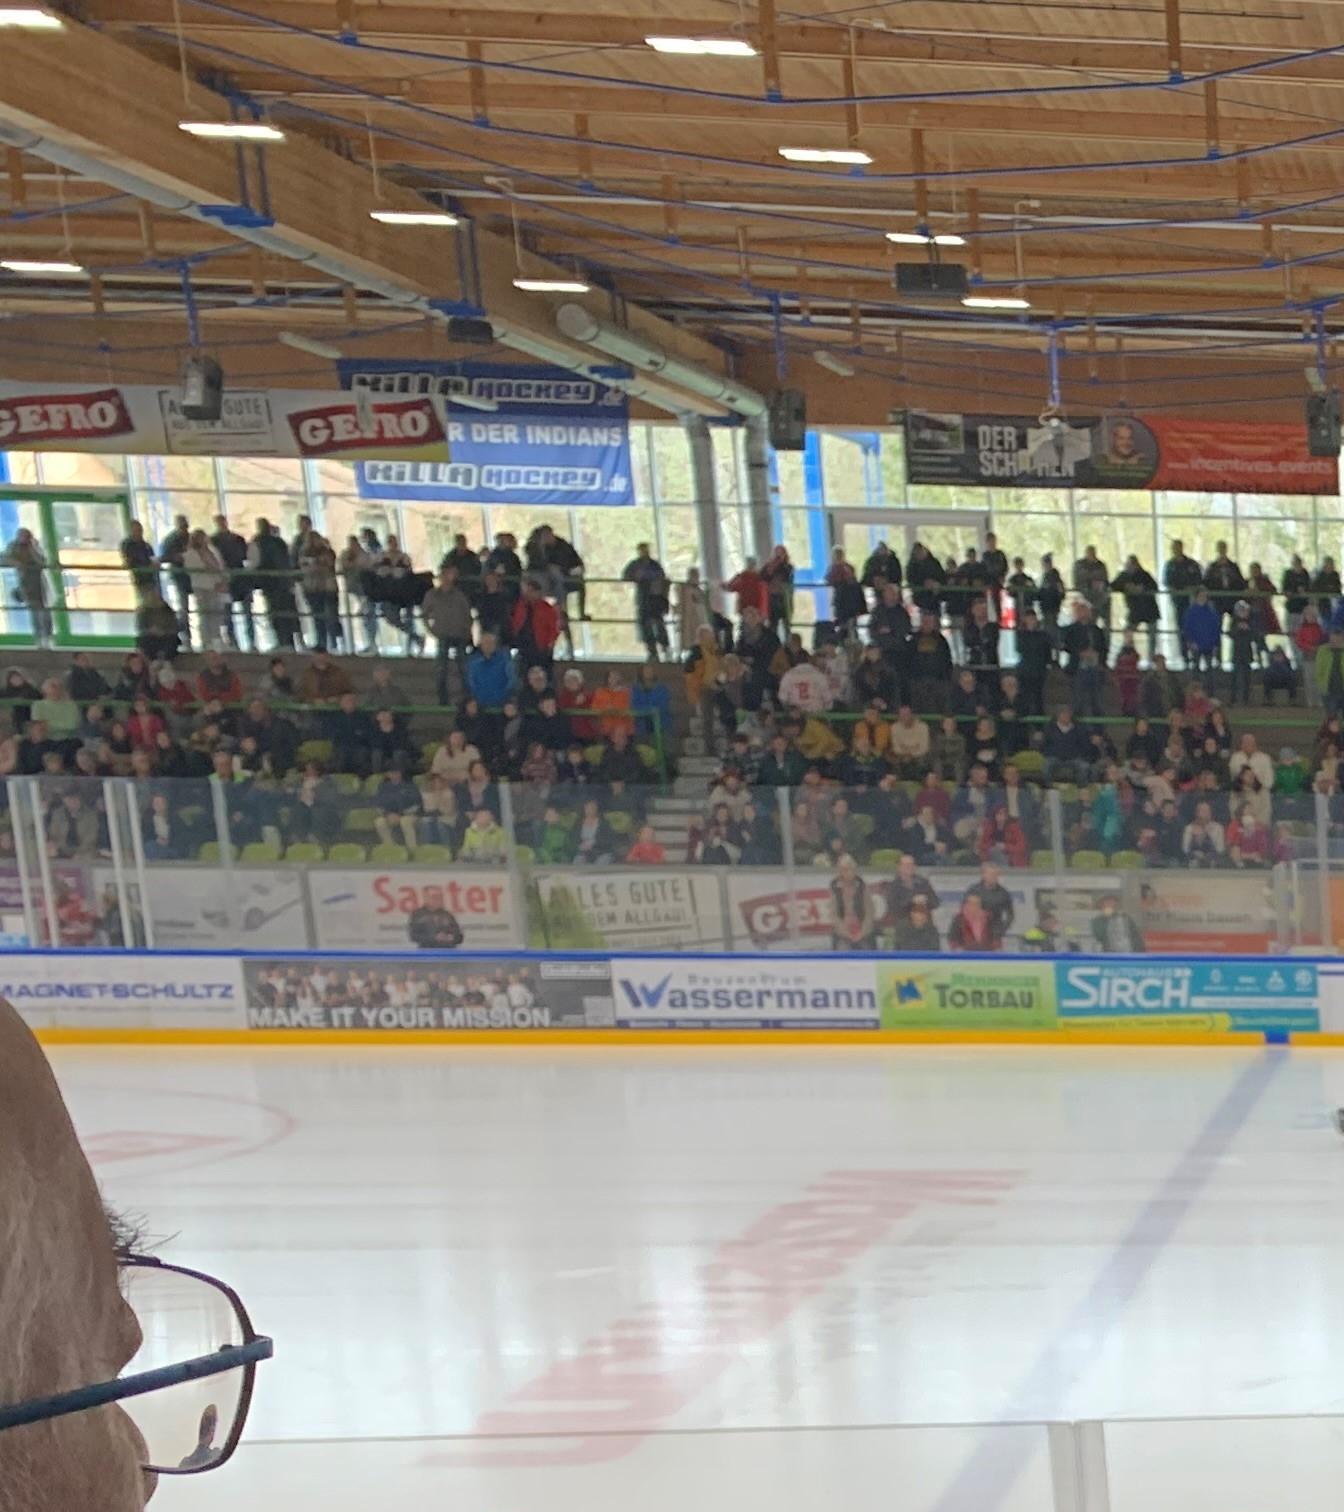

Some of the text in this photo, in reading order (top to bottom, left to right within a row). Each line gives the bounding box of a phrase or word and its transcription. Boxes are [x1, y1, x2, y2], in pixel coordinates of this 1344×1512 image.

[472, 423, 519, 444] DER
[527, 424, 622, 448] INDIANS
[977, 425, 1017, 450] DER
[619, 972, 877, 1010] Wassermann
[933, 983, 1035, 1009] TORBAU
[1061, 966, 1191, 1009] SIRCH
[250, 1006, 552, 1029] MAKE IT YOUR MISSION
